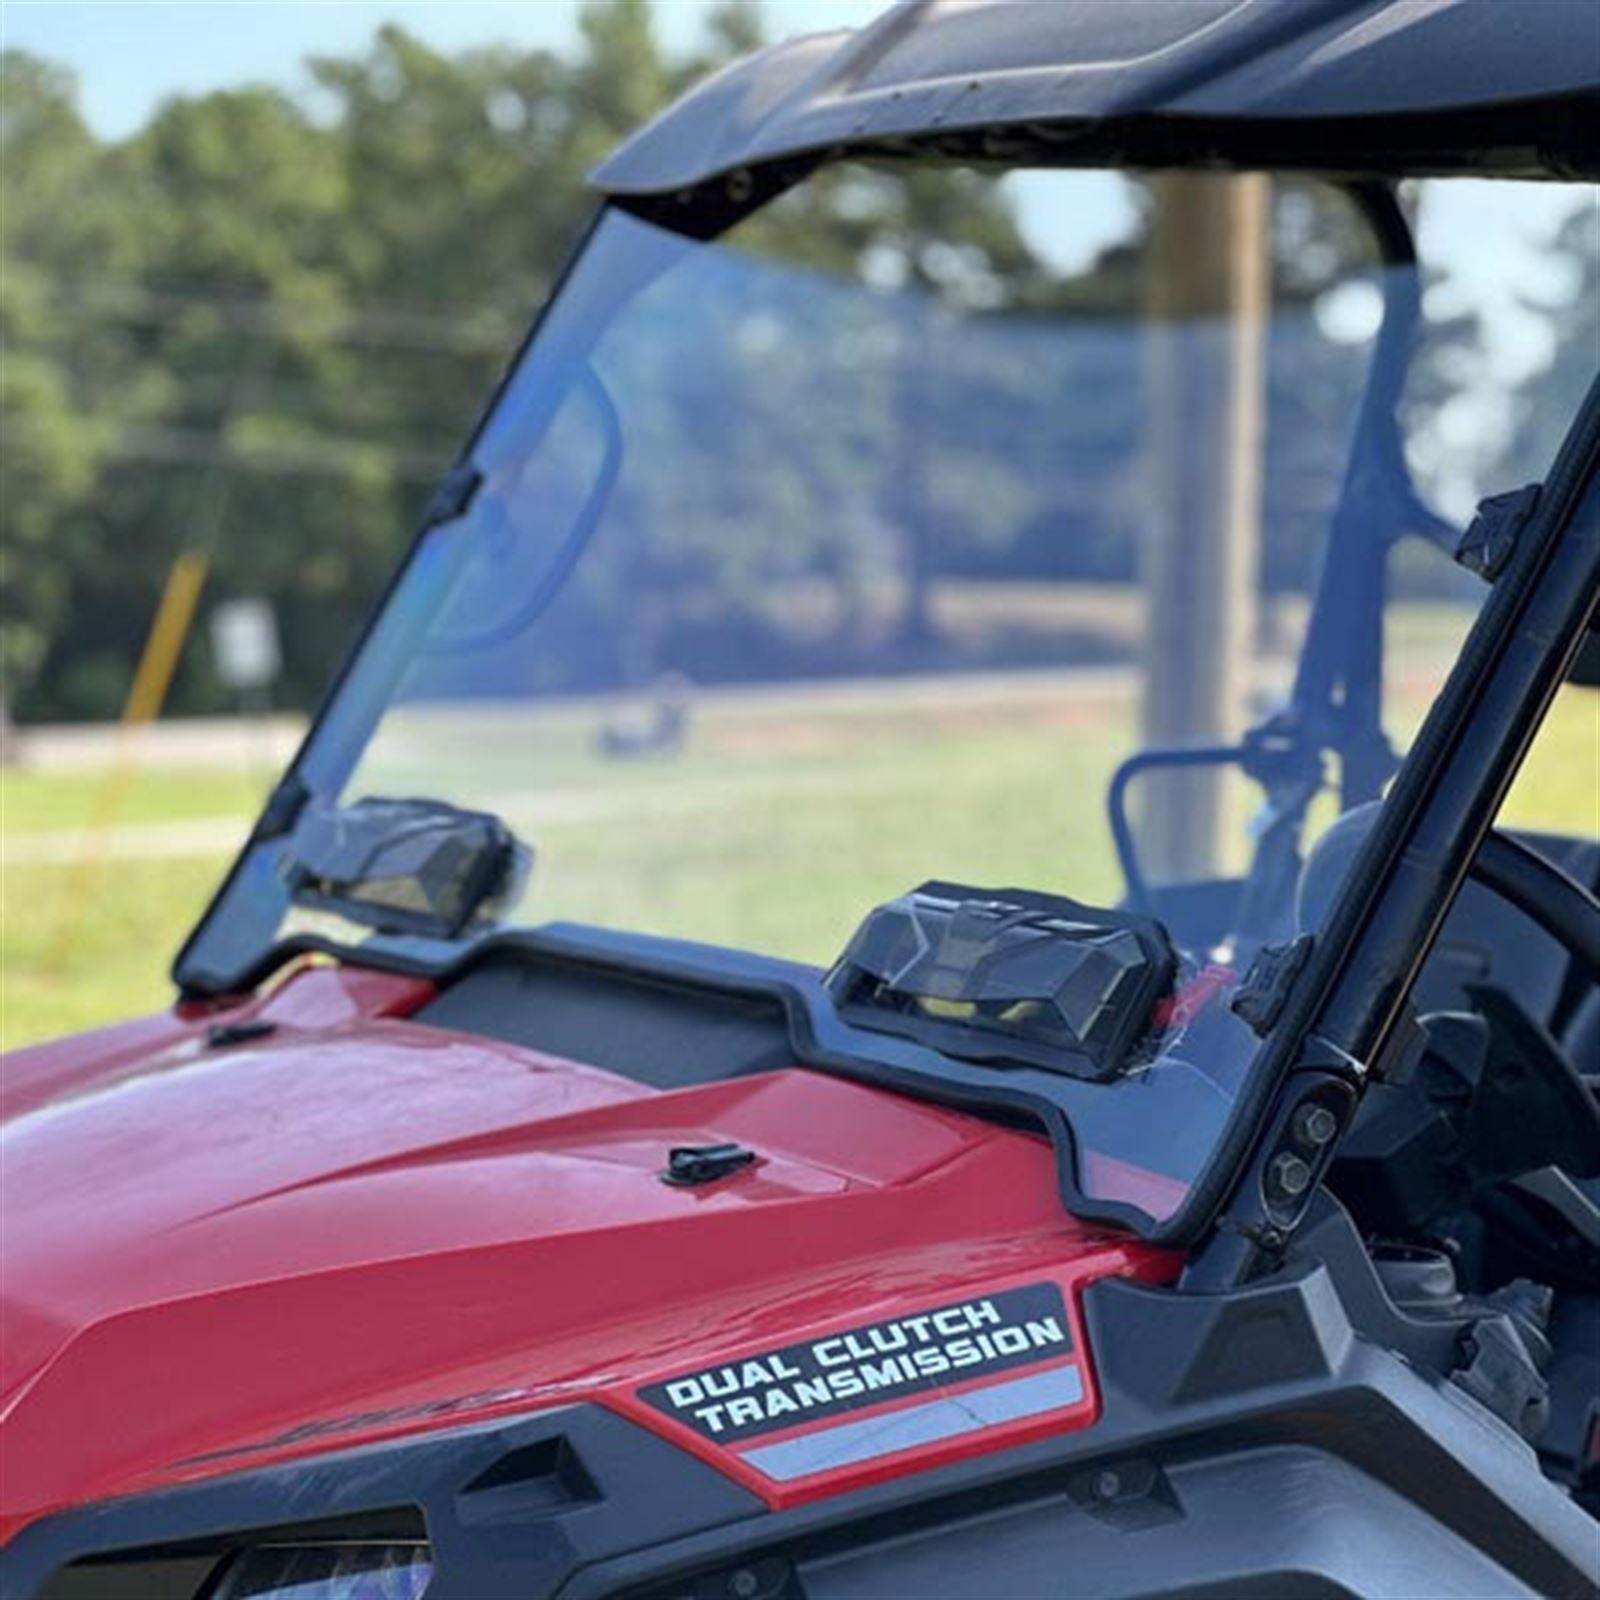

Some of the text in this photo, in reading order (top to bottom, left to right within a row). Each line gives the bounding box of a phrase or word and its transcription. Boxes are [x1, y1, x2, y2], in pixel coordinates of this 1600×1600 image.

[666, 1300, 1001, 1408] DUAL CLUTCH
[695, 1317, 1064, 1433] TRANSMISSION
